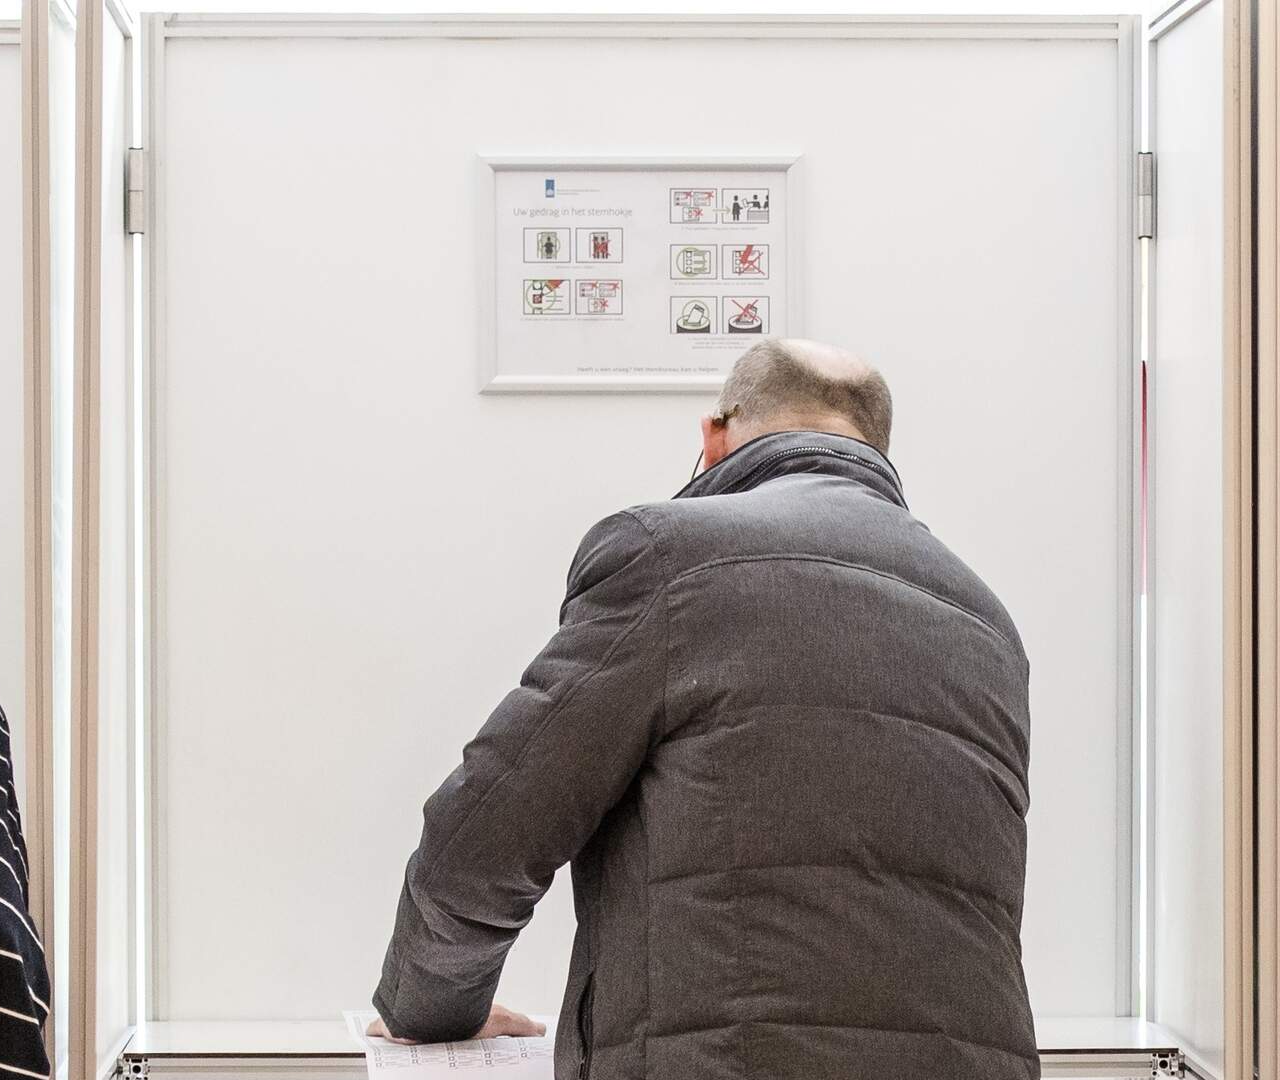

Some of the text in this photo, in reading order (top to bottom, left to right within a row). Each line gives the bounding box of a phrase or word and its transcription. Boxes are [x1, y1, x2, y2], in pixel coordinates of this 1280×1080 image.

[513, 207, 633, 218] Uw gedrag in het stemhokje
